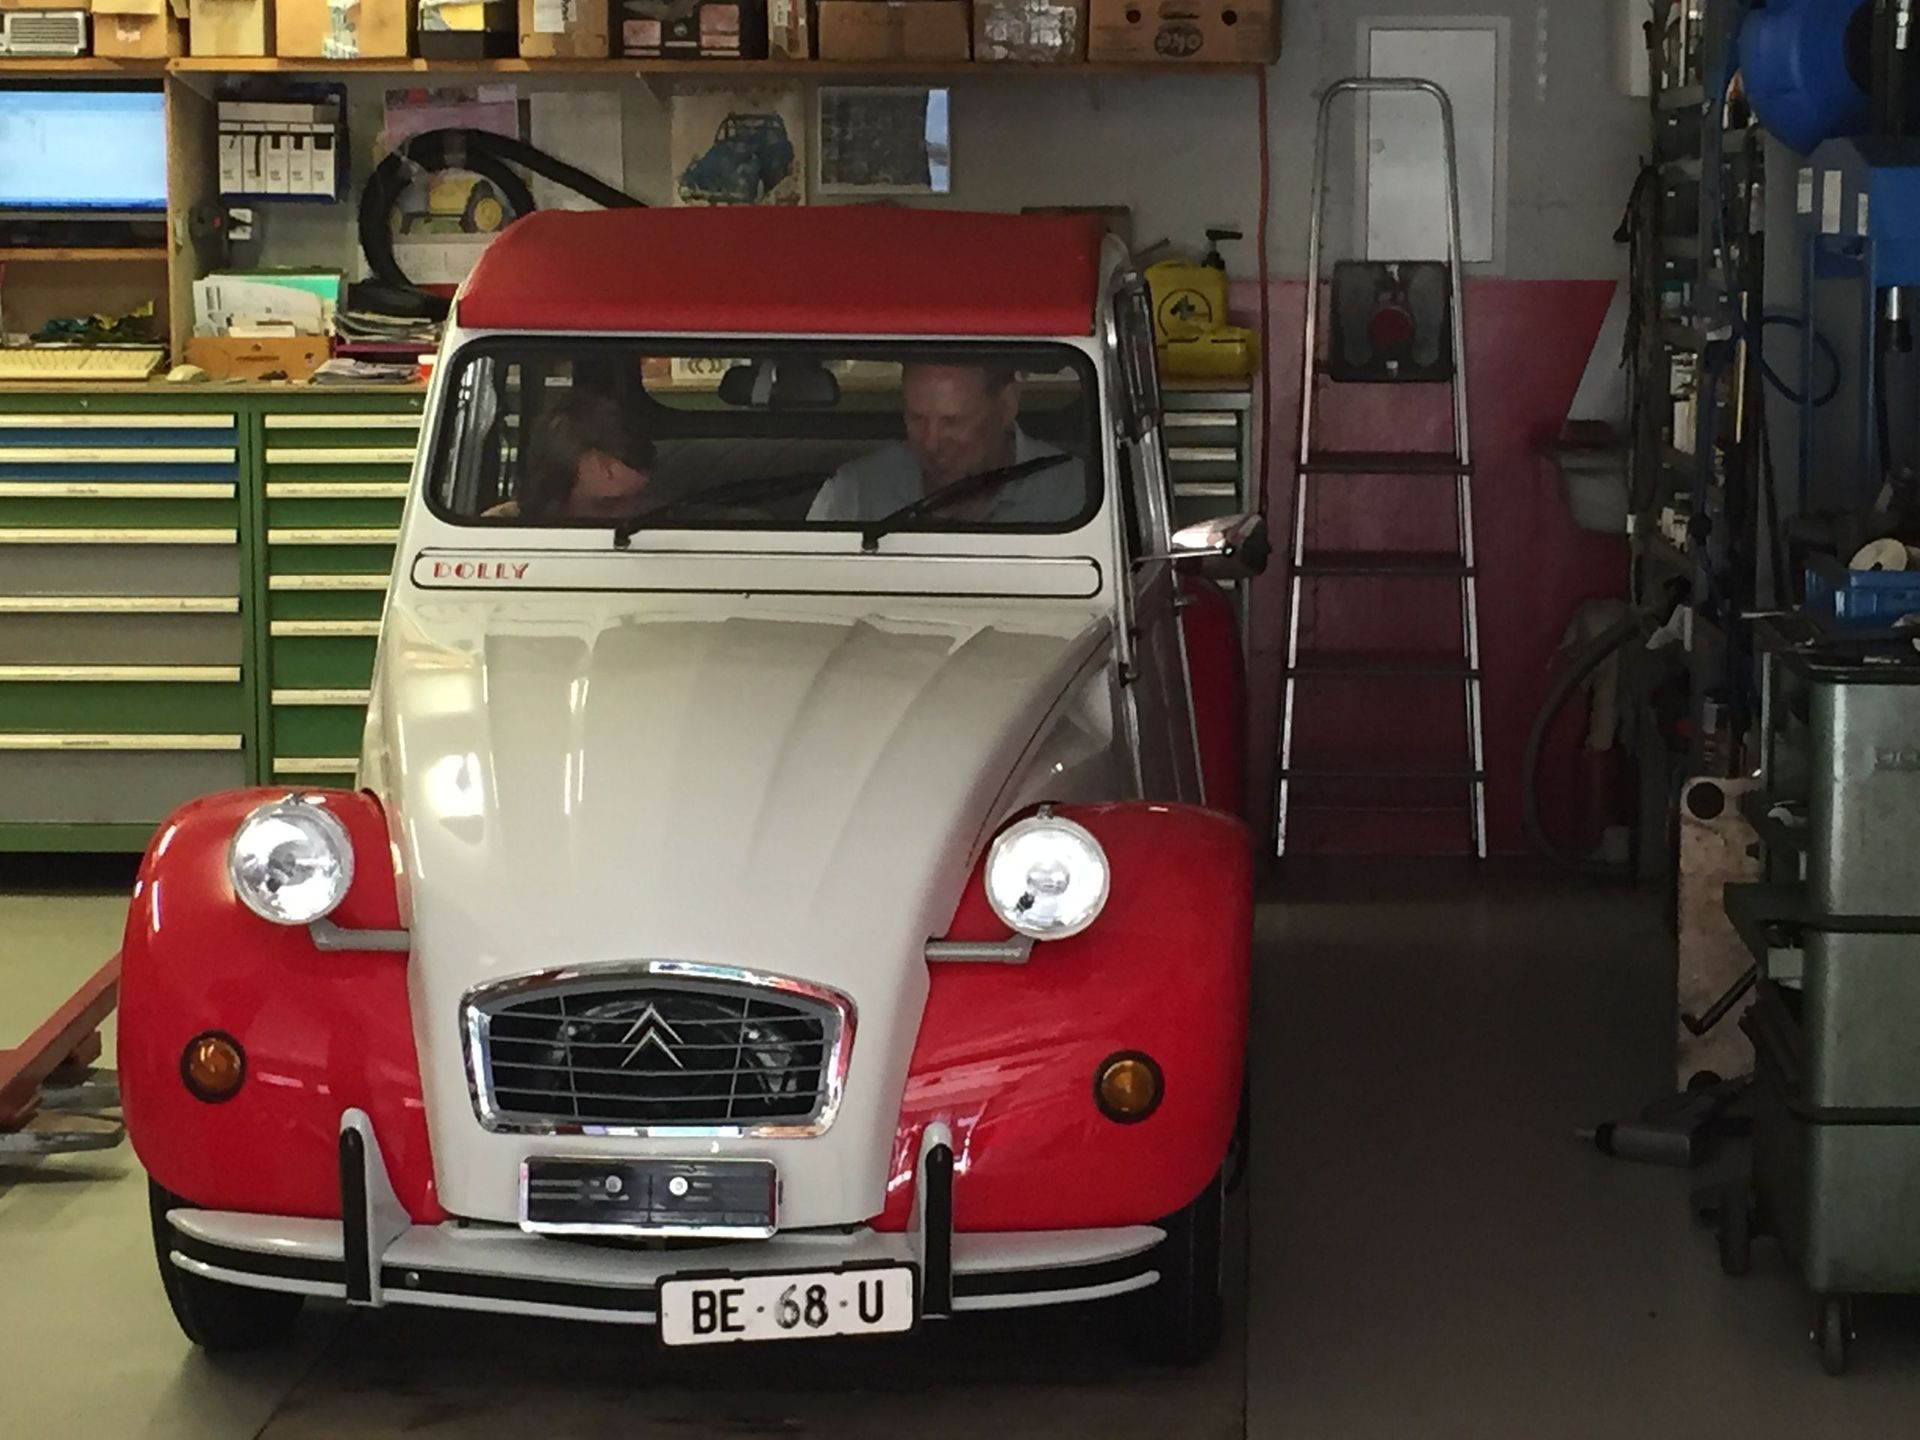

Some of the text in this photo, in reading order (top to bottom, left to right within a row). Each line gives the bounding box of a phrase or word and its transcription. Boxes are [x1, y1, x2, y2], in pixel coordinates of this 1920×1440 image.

[433, 561, 529, 580] DOLLY
[692, 1279, 884, 1335] BE 68 U
